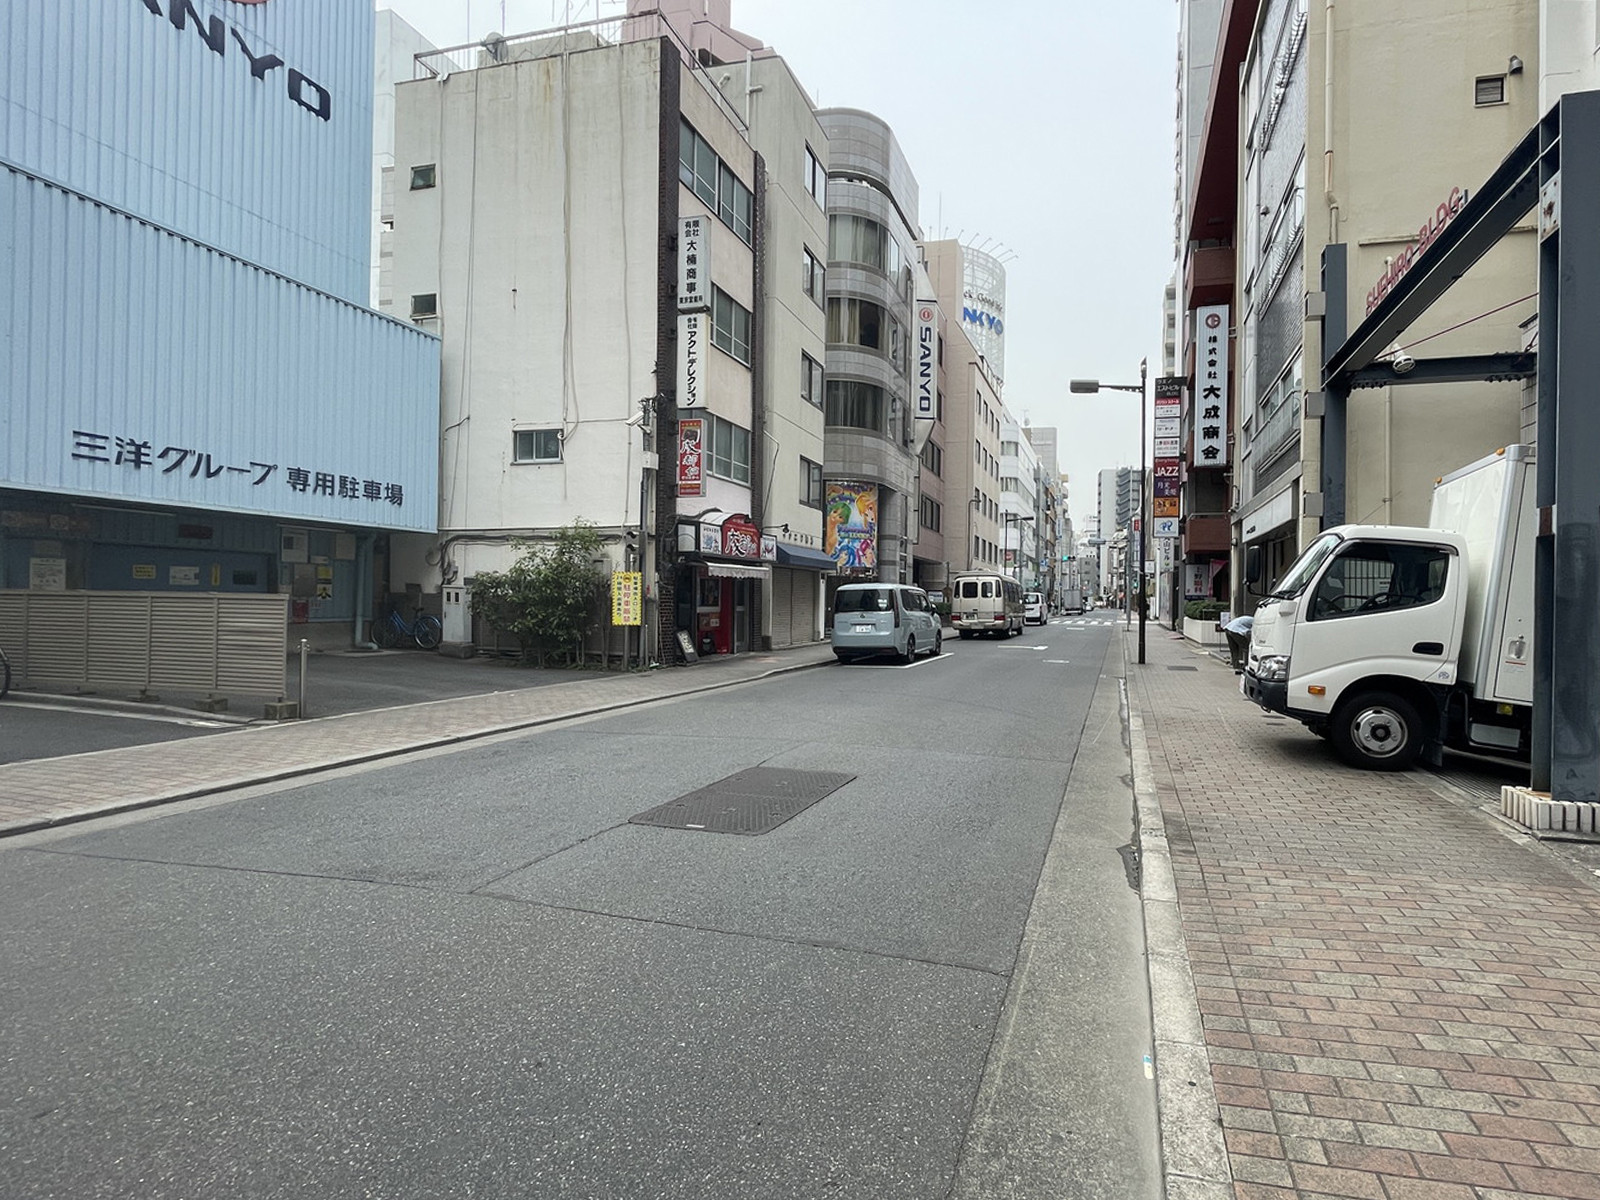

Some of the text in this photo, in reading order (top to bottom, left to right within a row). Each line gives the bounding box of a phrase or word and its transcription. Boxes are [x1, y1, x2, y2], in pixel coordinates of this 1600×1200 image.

[143, 0, 331, 121] NYO
[919, 326, 932, 412] SANYO
[71, 430, 404, 506] 三洋グループ 専用駐車場
[1155, 466, 1179, 476] JAZZ
[1163, 537, 1171, 560] 山ビル
